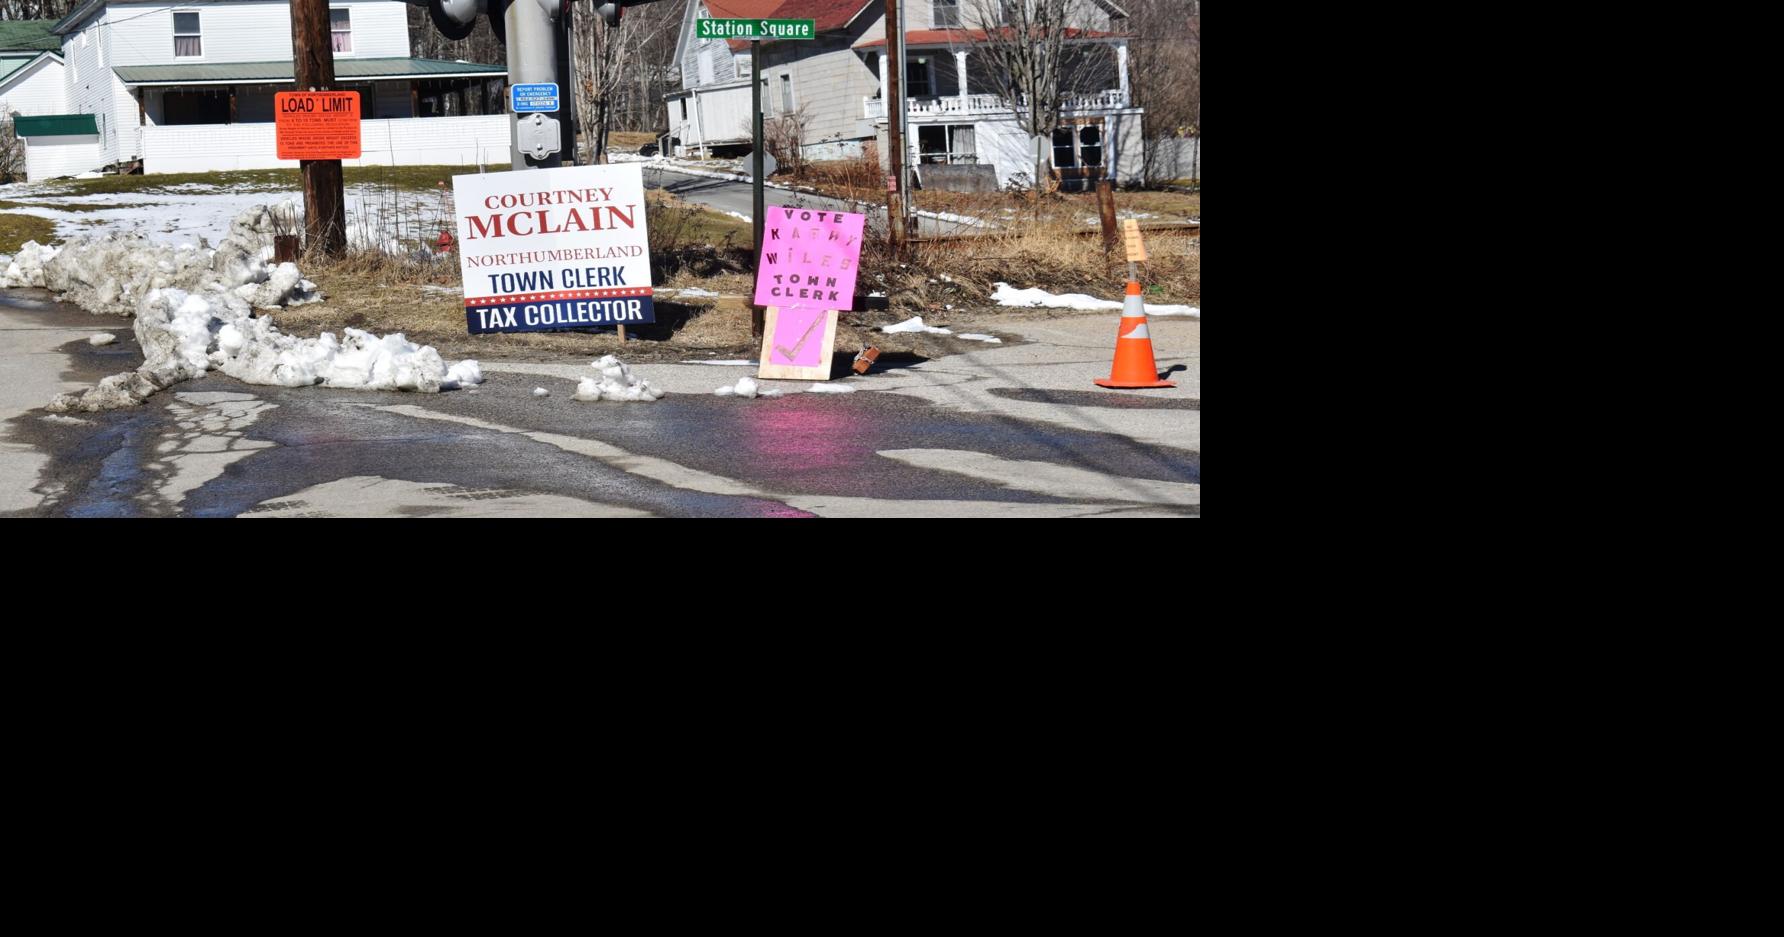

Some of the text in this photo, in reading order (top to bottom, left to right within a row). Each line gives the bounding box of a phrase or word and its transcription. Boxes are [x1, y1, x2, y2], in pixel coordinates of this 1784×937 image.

[702, 20, 809, 37] Station Square
[281, 97, 353, 113] LOAD LIMIT
[485, 187, 613, 210] COURTNEY
[465, 205, 636, 240] MCLAIN
[785, 209, 844, 224] VOTE
[771, 226, 857, 247] KATHY
[466, 245, 643, 268] NORTHUMBERLAND
[488, 265, 626, 294] TOWN CLERK
[773, 273, 837, 288] TOWN
[771, 286, 840, 302] CLERK
[476, 299, 643, 329] TAX COLLECTOR
